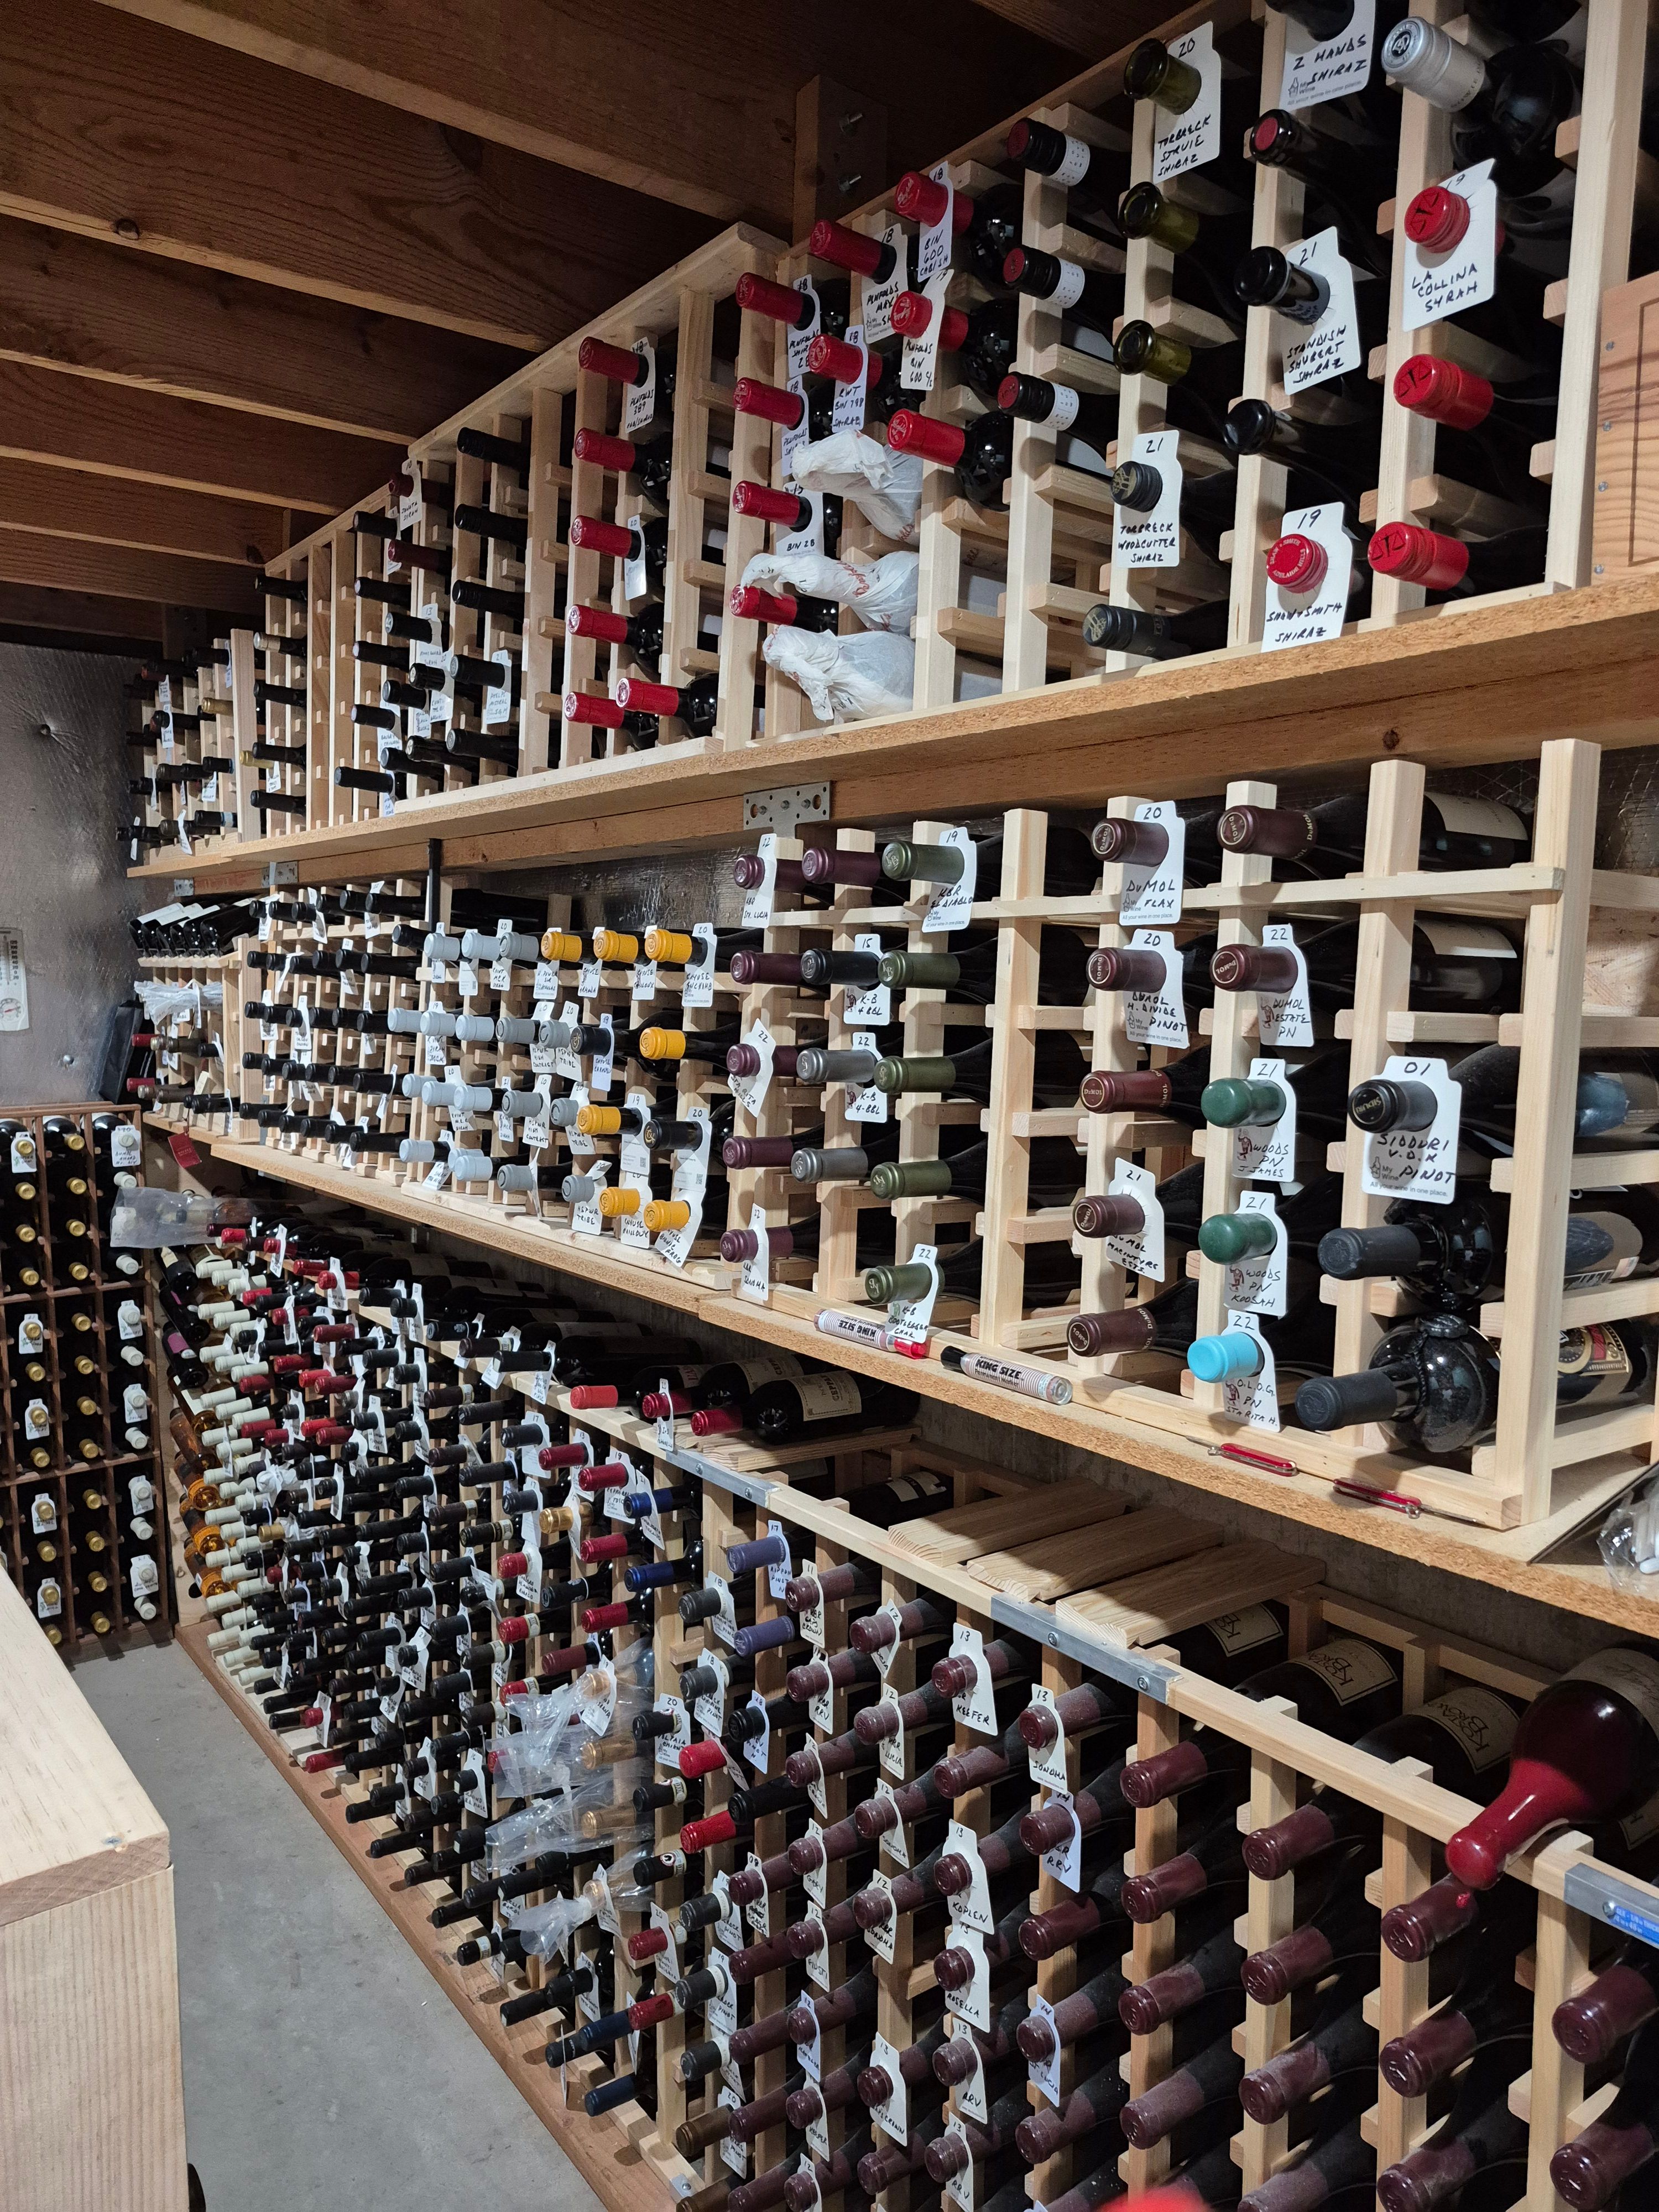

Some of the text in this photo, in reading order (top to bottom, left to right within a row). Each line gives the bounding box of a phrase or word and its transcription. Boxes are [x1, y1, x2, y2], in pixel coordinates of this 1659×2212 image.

[1178, 37, 1196, 58] 20
[1314, 34, 1366, 63] HANDS
[1307, 59, 1367, 85] SHIRAZ
[925, 229, 943, 250] BIN
[924, 245, 944, 264] 600
[1300, 242, 1317, 266] 21
[1412, 270, 1432, 290] LA
[1418, 263, 1478, 298] COLLINA
[1425, 280, 1478, 312] SYRAH
[1287, 325, 1347, 358] STANDISH
[911, 358, 925, 369] BIN
[1146, 437, 1163, 453] 21
[1297, 509, 1321, 529] 19
[1120, 522, 1173, 535] TORBRECK
[1130, 554, 1164, 563] SHIRAZ
[1275, 627, 1327, 643] SHIRAZ
[1144, 807, 1162, 820] 20
[946, 831, 958, 843] 19
[1144, 899, 1174, 909] FLAX
[1144, 933, 1161, 946] 20
[1270, 928, 1288, 940] 22
[862, 938, 873, 949] 15
[1149, 1016, 1187, 1032] PINOT
[1274, 1013, 1311, 1024] ESTATE
[758, 1030, 769, 1044] 22
[1279, 1025, 1297, 1038] PN
[858, 1036, 870, 1046] 22
[1257, 1063, 1278, 1078] 21
[1404, 1062, 1431, 1076] 01
[1259, 1155, 1284, 1167] PN
[1126, 1170, 1141, 1181] 21
[1382, 1165, 1392, 1173] My
[1399, 1165, 1455, 1184] PINOT
[1382, 1173, 1399, 1181] Wine
[1430, 1188, 1448, 1197] place.
[1245, 1197, 1266, 1209] 21
[919, 1248, 931, 1259] 22
[1249, 1281, 1272, 1292] PN
[1231, 1294, 1276, 1308] KOOSAH
[838, 1319, 877, 1338] KING SIZE
[1234, 1315, 1255, 1331] 22
[975, 1359, 1022, 1380] KING SIZE
[1243, 1397, 1262, 1409] PN
[959, 1631, 971, 1641] 13
[667, 1697, 677, 1707] 20
[1037, 1690, 1048, 1702] 13
[956, 1703, 990, 1726] KEEFER
[1032, 1760, 1066, 1781] SONOMA
[956, 1827, 964, 1838] 13
[877, 1877, 888, 1890] 12
[947, 1992, 979, 2019] ROSELLA
[958, 2023, 968, 2035] 13
